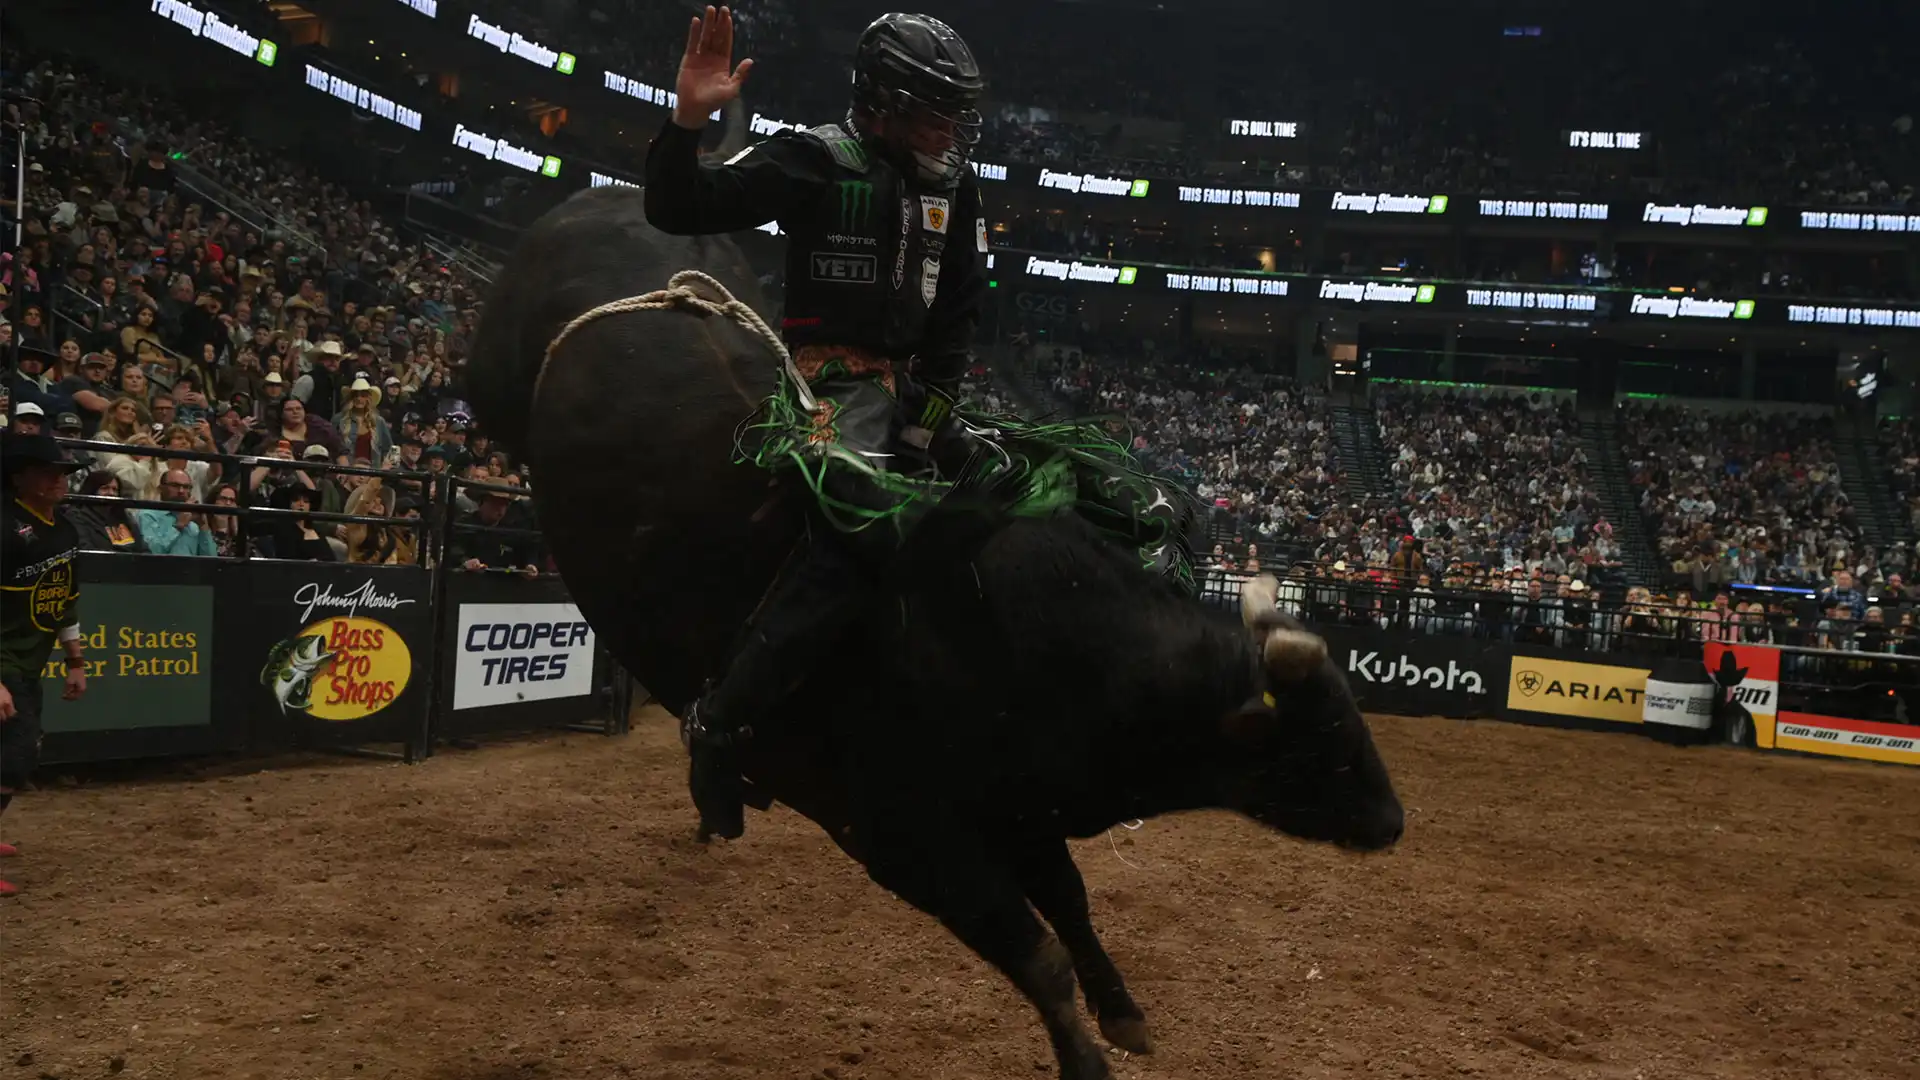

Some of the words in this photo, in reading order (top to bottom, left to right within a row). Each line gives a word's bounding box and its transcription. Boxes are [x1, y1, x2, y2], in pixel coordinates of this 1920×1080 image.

[202, 12, 260, 58] Simulator
[467, 14, 511, 53] Farming
[508, 32, 558, 68] Simulator
[305, 64, 328, 92] THIS
[329, 75, 358, 105] FARM
[358, 88, 369, 109] IS
[370, 92, 395, 121] YOUR
[396, 104, 422, 131] FARM
[604, 71, 626, 94] THIS
[627, 79, 653, 103] FARM
[654, 88, 666, 106] IS
[1231, 120, 1249, 136] IT'S
[1274, 121, 1297, 138] TIME
[1570, 131, 1589, 147] IT'S
[1616, 132, 1641, 149] TIME
[452, 123, 496, 160] Farming
[494, 138, 544, 172] Simulator
[979, 163, 1007, 180] FARM
[1038, 168, 1082, 193] Farming
[1081, 174, 1132, 196] Simulator
[1178, 186, 1202, 203] THIS
[1203, 188, 1230, 204] FARM
[1231, 190, 1244, 205] IS
[1244, 190, 1271, 207] YOUR
[1272, 192, 1300, 208] FARM
[1331, 192, 1377, 214] Farming
[1376, 193, 1429, 214] Simulator
[1479, 199, 1504, 216] THIS
[1504, 200, 1534, 217] FARM
[1535, 201, 1548, 217] IS
[1548, 202, 1577, 219] YOUR
[1579, 203, 1609, 220] FARM
[1642, 202, 1693, 227] Farming
[1690, 203, 1749, 226] Simulator
[1800, 211, 1828, 228] THIS
[1828, 212, 1861, 230] FARM
[1861, 214, 1875, 230] IS
[1876, 214, 1906, 231] YOUR
[1907, 215, 1920, 232] FA
[827, 232, 877, 246] MONSTER
[815, 258, 871, 279] YETI
[1025, 256, 1069, 281] Farming
[1068, 261, 1120, 283] Simulator
[1166, 273, 1190, 290] THIS
[1190, 275, 1218, 292] FARM
[1219, 277, 1230, 292] IS
[1231, 278, 1259, 294] YOUR
[1259, 280, 1288, 296] FARM
[1319, 280, 1365, 302] Farming
[1363, 281, 1417, 302] Simulator
[1466, 289, 1492, 306] THIS
[1492, 290, 1522, 308] FARM
[1523, 292, 1535, 309] IS
[1536, 293, 1565, 309] YOUR
[1566, 294, 1596, 311] FARM
[1629, 294, 1680, 319] Farming
[1677, 295, 1736, 318] Simulator
[1788, 305, 1815, 322] THIS
[1815, 306, 1847, 323] FARM
[1848, 307, 1862, 324] IS
[1862, 308, 1894, 326] YOUR
[294, 583, 358, 623] Johnny
[346, 578, 416, 609] Morris
[118, 626, 197, 649] States
[328, 620, 385, 650] Bass
[464, 622, 588, 653] COOPER
[117, 651, 200, 677] Patrol
[327, 649, 370, 678] Pro
[481, 654, 569, 686] TIRES
[1348, 649, 1482, 694] Kubota
[326, 676, 395, 710] Shops
[1545, 679, 1645, 704] ARIAT
[1783, 725, 1840, 741] can-am
[1851, 733, 1914, 750] can-am
